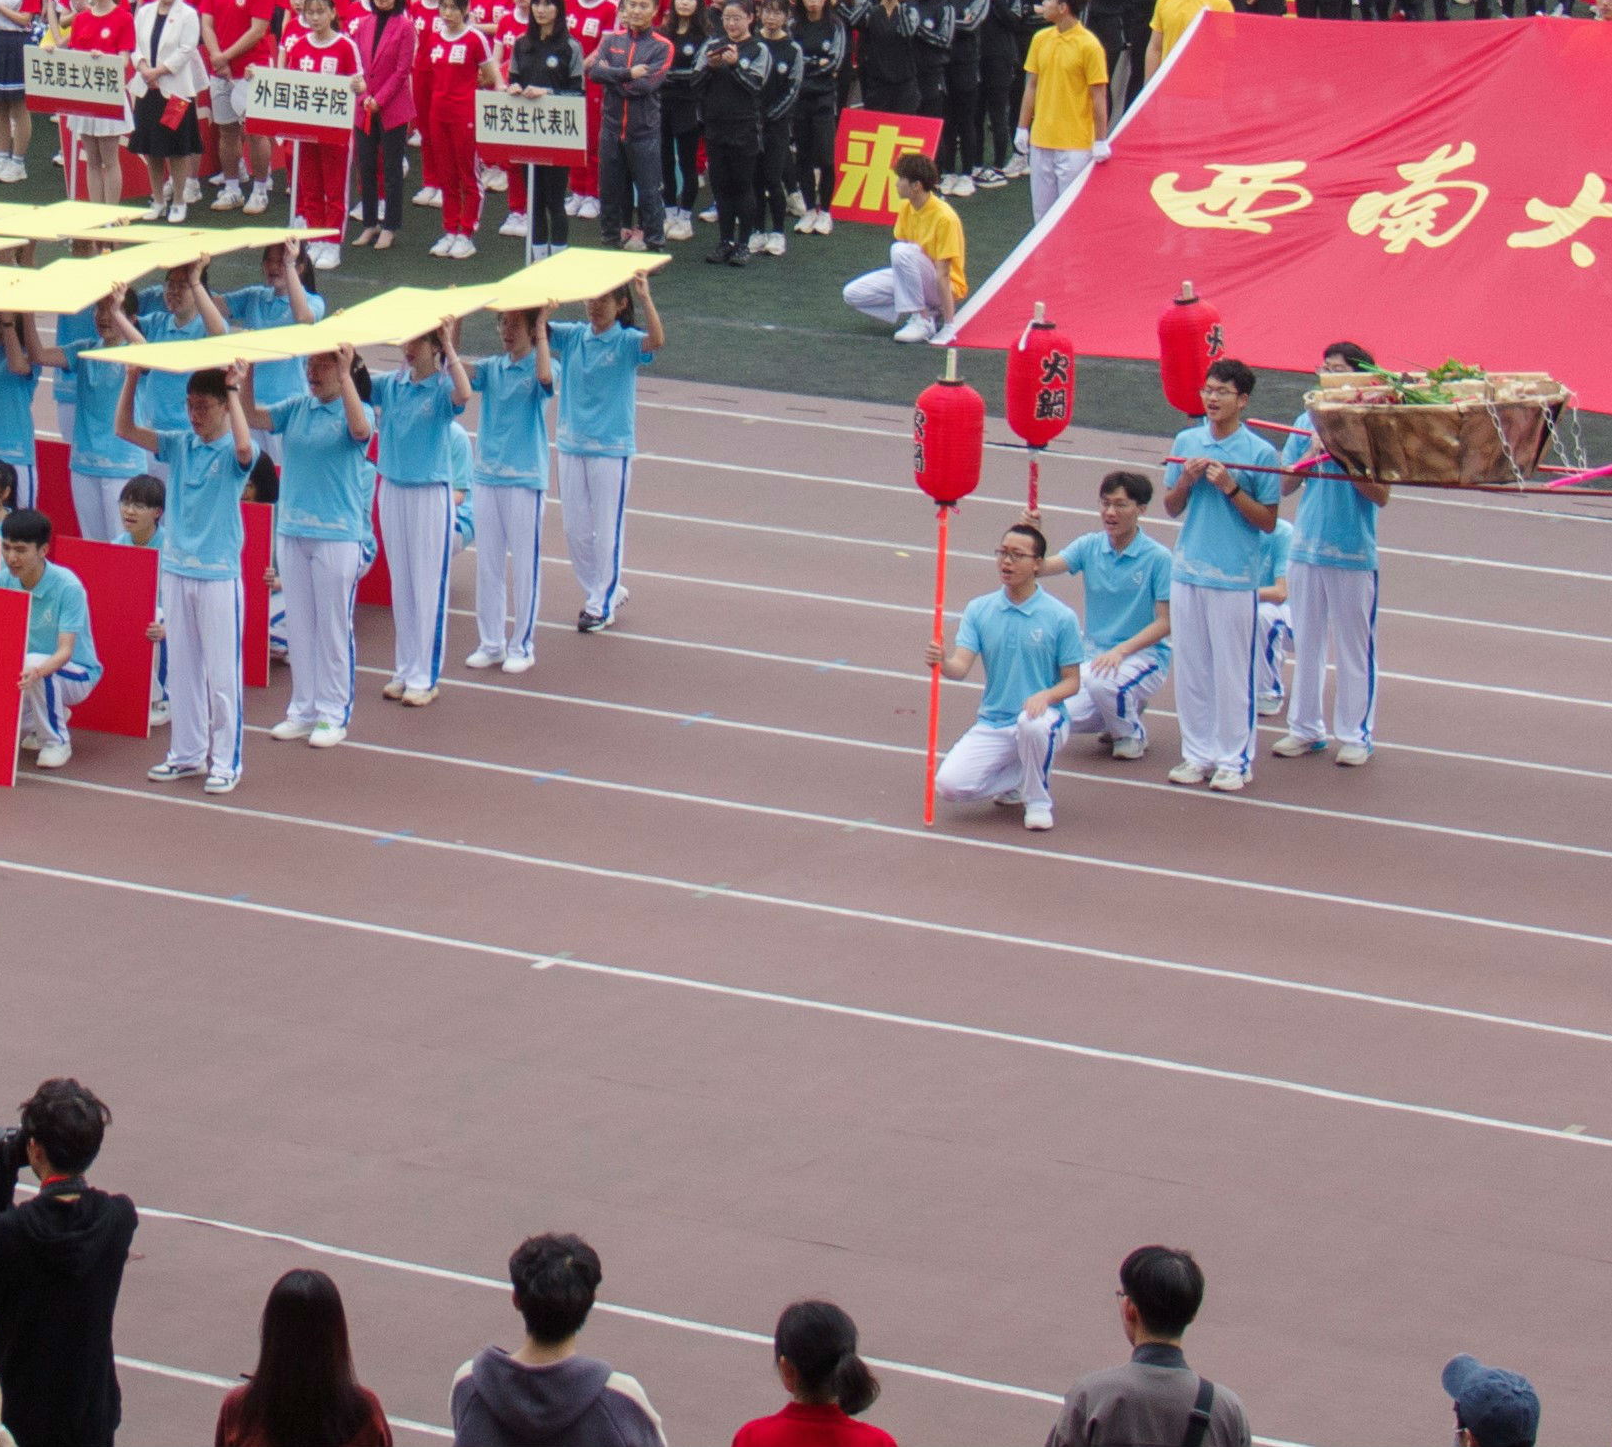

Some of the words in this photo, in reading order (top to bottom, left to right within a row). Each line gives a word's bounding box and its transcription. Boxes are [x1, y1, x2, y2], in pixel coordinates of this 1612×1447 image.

[430, 44, 467, 65] 中国
[30, 59, 119, 95] 马克思主义学院
[254, 81, 348, 117] 外国语学院
[482, 106, 580, 142] 研究生代表队
[831, 125, 925, 214] 来
